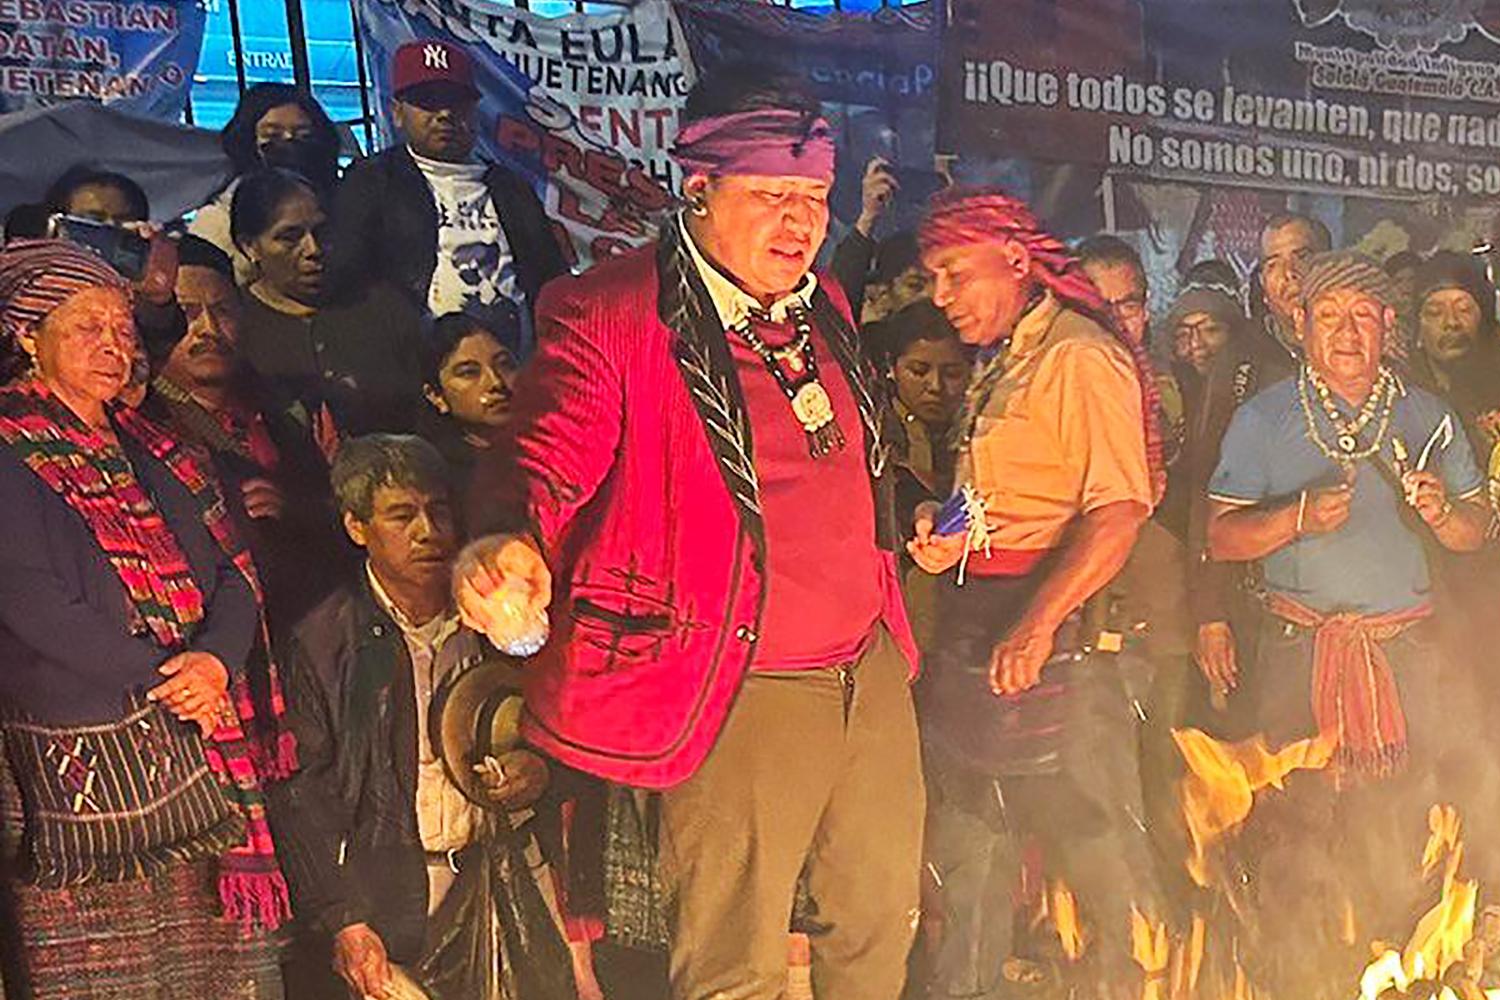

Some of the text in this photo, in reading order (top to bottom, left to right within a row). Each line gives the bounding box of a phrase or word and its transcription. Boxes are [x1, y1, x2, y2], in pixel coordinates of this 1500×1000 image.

[423, 44, 448, 69] NY
[1067, 72, 1165, 116] todos
[1174, 87, 1214, 120] se
[1222, 86, 1375, 140] levanten,
[1382, 108, 1441, 144] que
[1108, 124, 1153, 166] No
[1161, 137, 1276, 177] somos
[1281, 147, 1350, 185] uno,
[1358, 152, 1388, 186] ni
[1394, 154, 1460, 196] dos,
